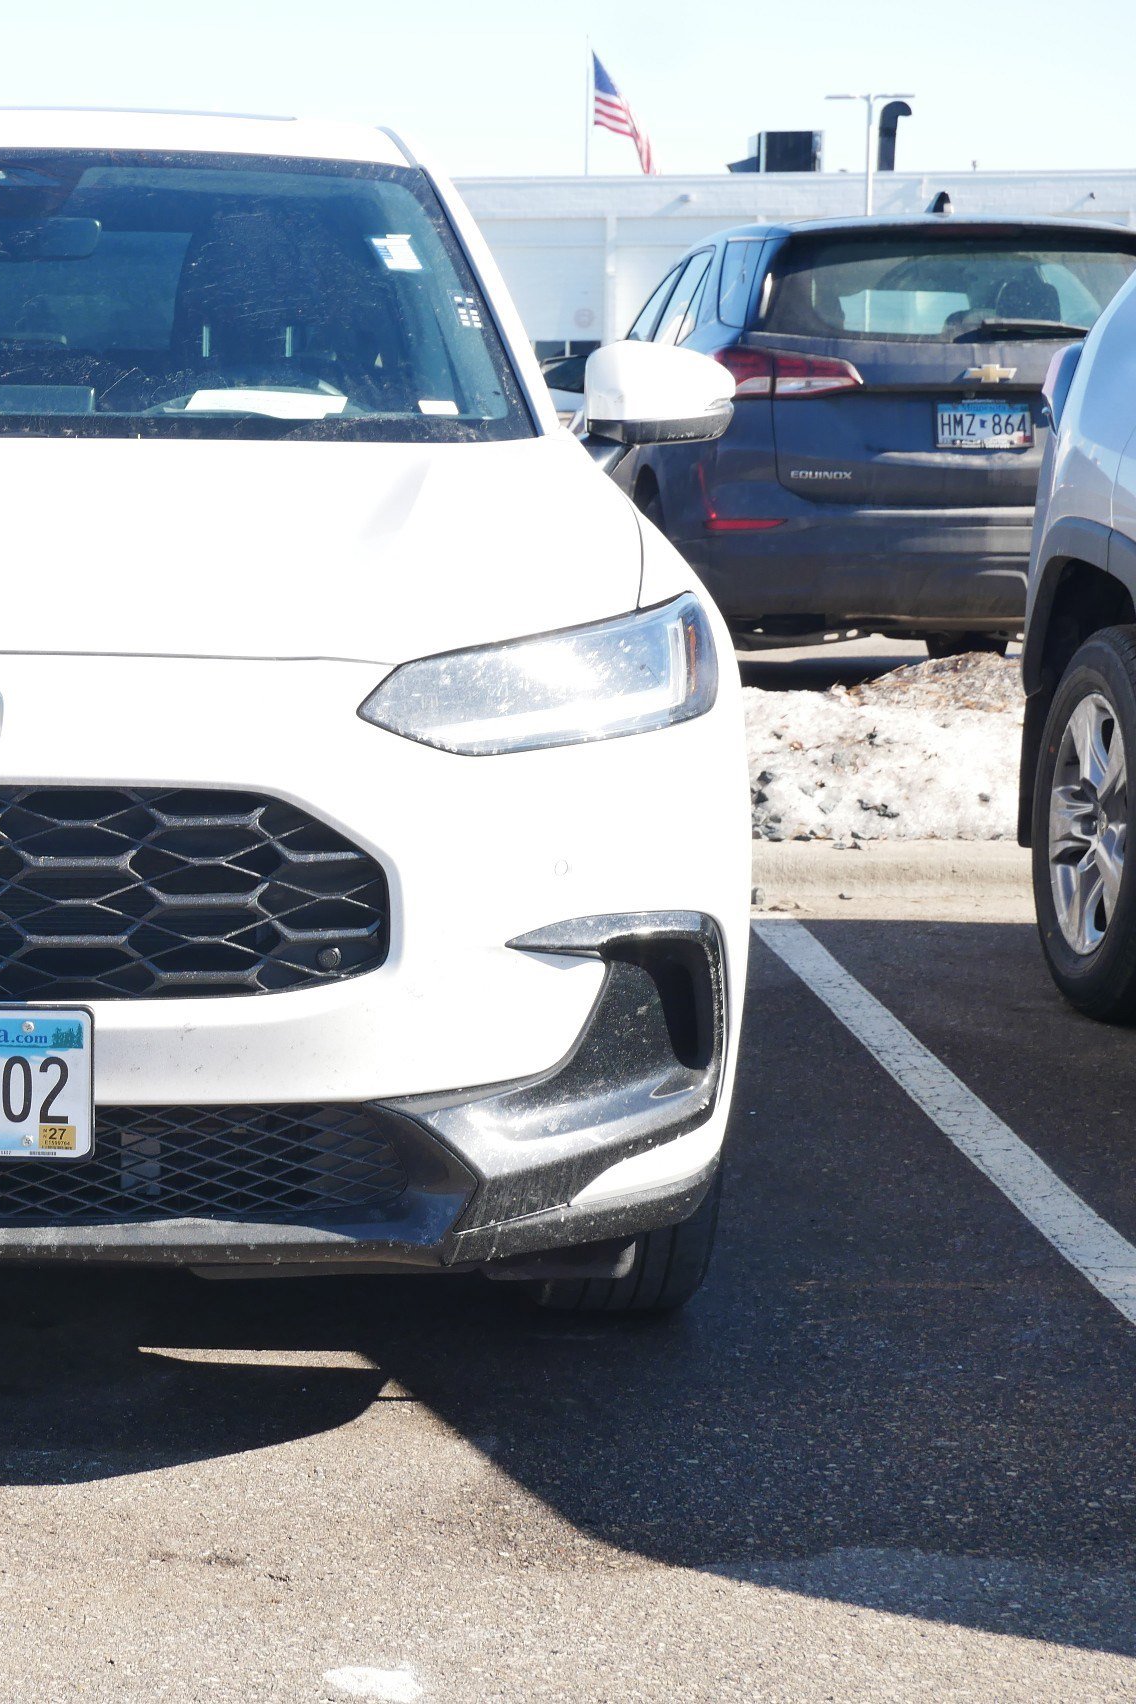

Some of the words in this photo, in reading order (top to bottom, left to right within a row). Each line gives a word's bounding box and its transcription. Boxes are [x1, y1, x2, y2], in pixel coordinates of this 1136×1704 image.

[940, 413, 976, 436] HMZ
[992, 413, 1027, 437] 864
[790, 470, 852, 480] EQUINOX
[48, 1127, 67, 1140] 27
